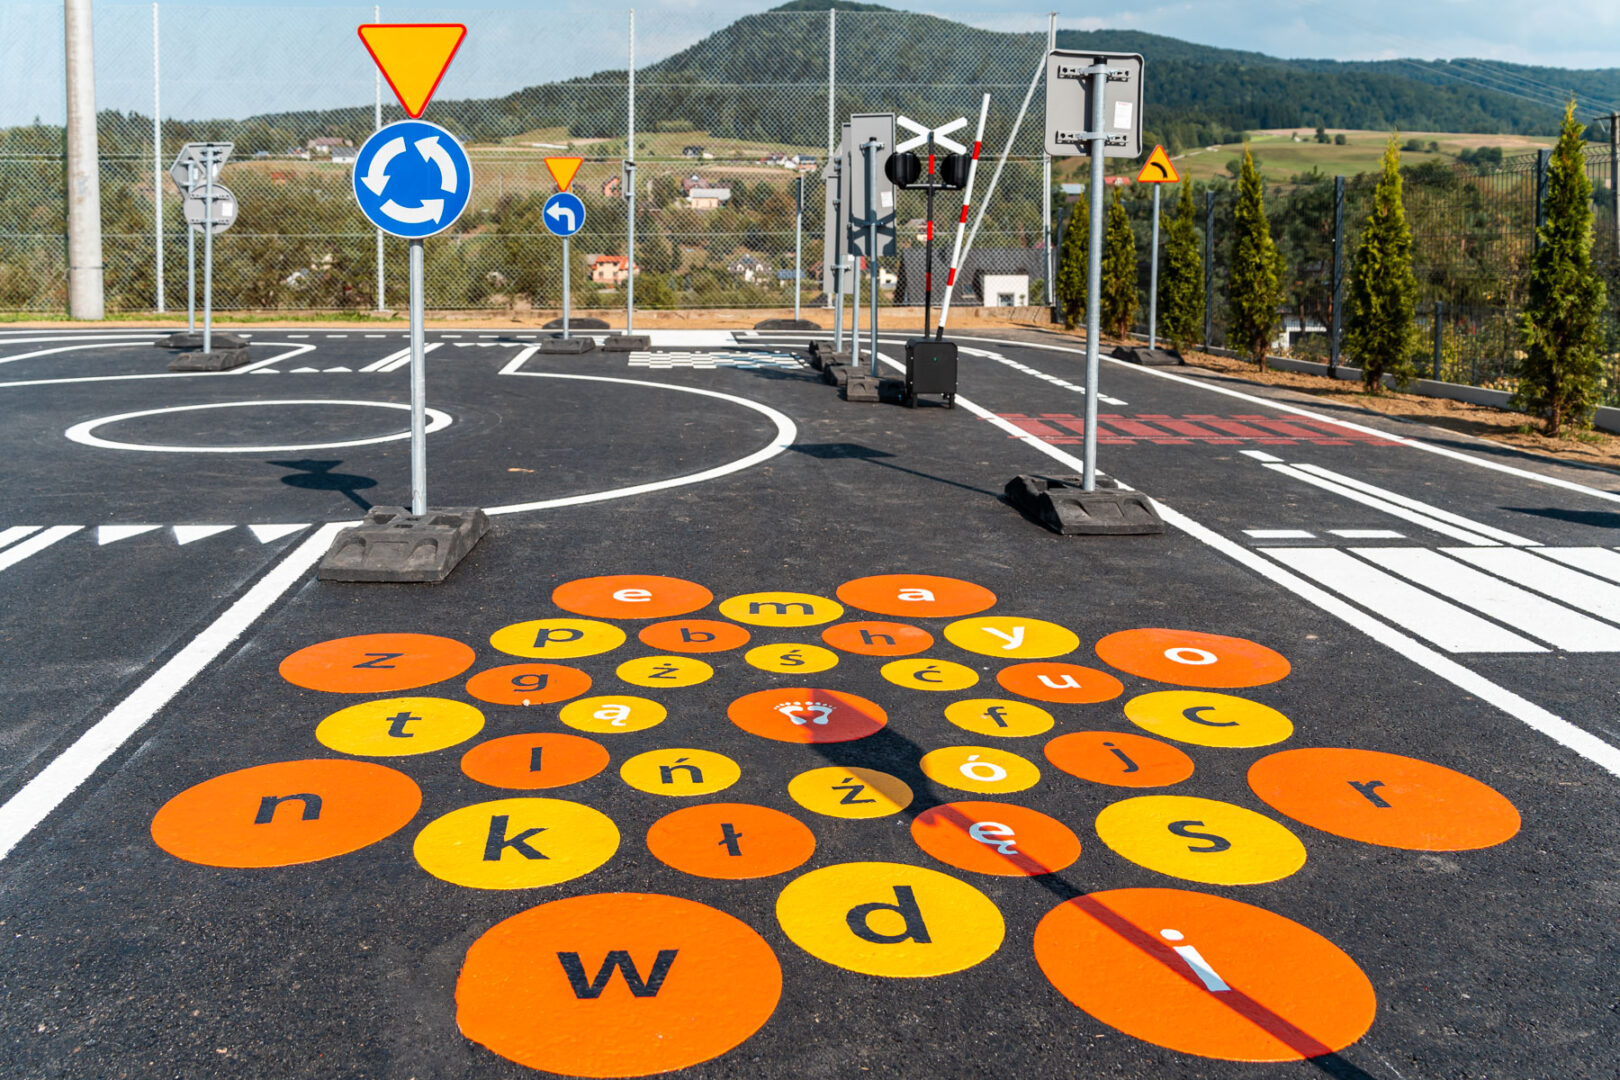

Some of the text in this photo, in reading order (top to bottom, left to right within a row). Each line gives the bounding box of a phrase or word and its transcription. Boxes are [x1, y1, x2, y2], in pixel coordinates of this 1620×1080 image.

[613, 589, 652, 602] e
[898, 589, 935, 601] a
[749, 602, 814, 614] m
[533, 628, 584, 647] p
[680, 627, 716, 642] b
[859, 629, 895, 644] h
[982, 627, 1024, 650] y
[353, 652, 404, 668] z
[780, 649, 805, 665] ś
[1164, 648, 1218, 665] o
[648, 662, 678, 678] ż
[913, 665, 943, 682] ć
[511, 674, 549, 691] g
[1038, 675, 1080, 688] u
[386, 711, 422, 737] t
[594, 705, 630, 726] ą
[983, 706, 1008, 727] f
[1182, 706, 1239, 726] c
[1103, 742, 1139, 772] j
[659, 757, 704, 783] ń
[960, 755, 1007, 781] ó
[831, 777, 876, 804] ź
[1347, 780, 1392, 807] r
[254, 793, 323, 824] n
[482, 815, 550, 861] k
[718, 823, 743, 856] ł
[969, 822, 1018, 854] ę
[1167, 820, 1232, 852] s
[845, 885, 932, 944] d
[1160, 929, 1231, 992] i
[556, 949, 679, 998] w
